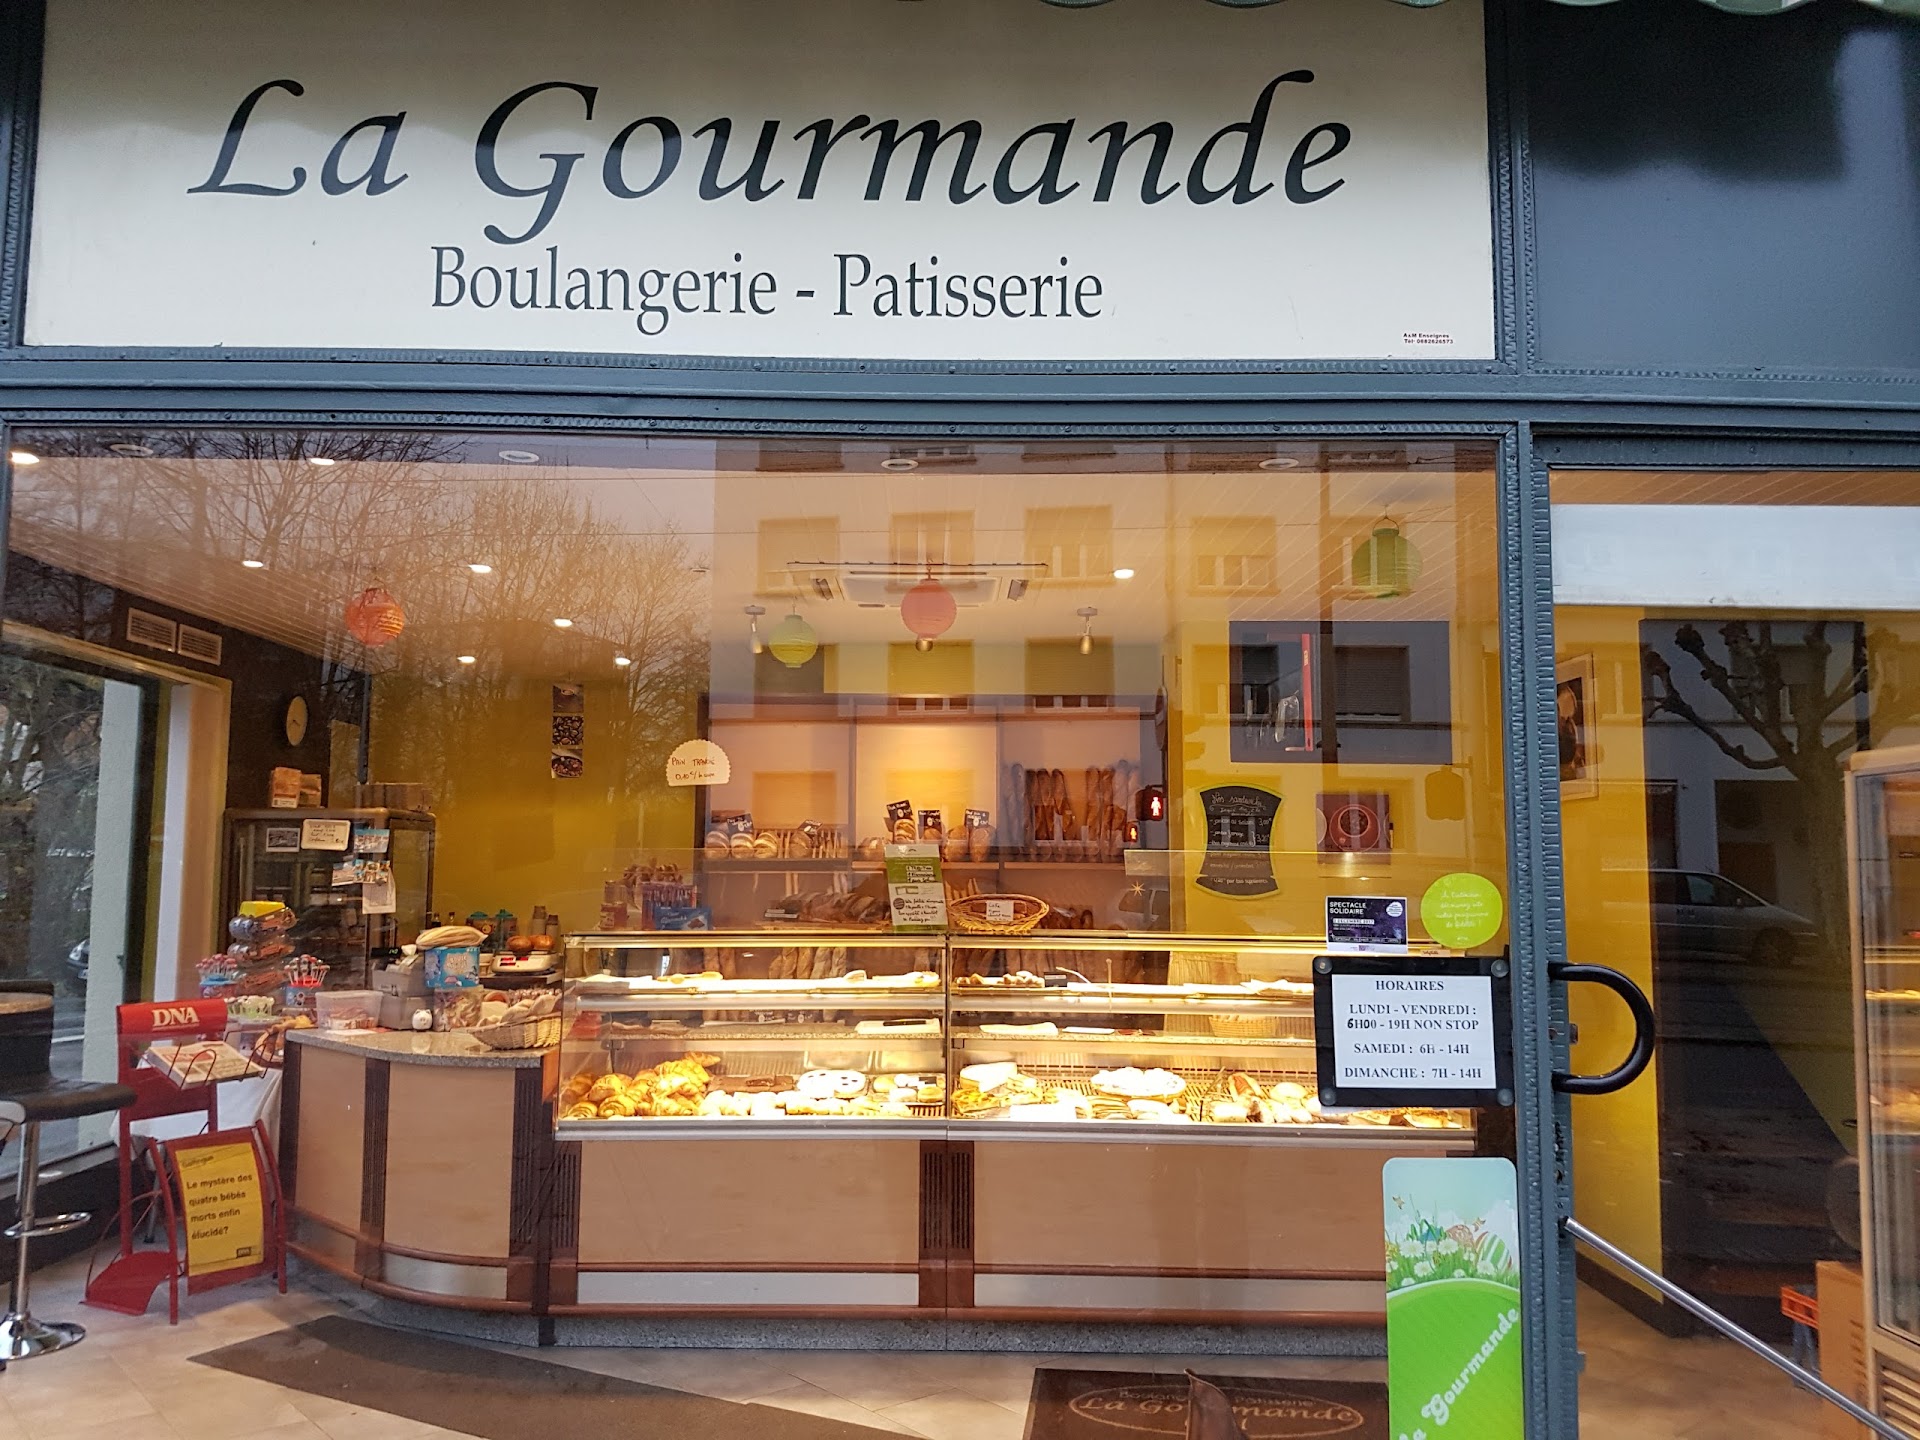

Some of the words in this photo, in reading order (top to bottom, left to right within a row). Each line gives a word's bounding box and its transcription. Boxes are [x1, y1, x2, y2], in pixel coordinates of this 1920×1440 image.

[187, 79, 408, 199] La
[475, 69, 1352, 244] Gourmande
[431, 245, 777, 336] Boulangerie
[796, 289, 815, 297] -
[832, 253, 1104, 319] Patisserie
[1329, 901, 1367, 909] SPECTACLE
[1376, 980, 1444, 991] HORAIRES
[152, 1006, 199, 1027] DNA
[1349, 1004, 1390, 1014] LUNDI
[1402, 1005, 1469, 1015] VENDREDI
[1347, 1018, 1377, 1029] 6H00
[1388, 1019, 1410, 1030] 19H
[1414, 1019, 1443, 1030] NON
[1445, 1020, 1479, 1030] STOP
[1354, 1043, 1405, 1054] SAMEDI
[1419, 1044, 1436, 1054] 6H
[1447, 1044, 1469, 1054] 14H
[1344, 1068, 1418, 1078] DIMANCHE
[1431, 1068, 1448, 1078] 7H
[1460, 1068, 1482, 1079] 14H
[186, 1181, 198, 1190] Le
[200, 1175, 235, 1188] mystère
[237, 1174, 252, 1183] des
[189, 1195, 218, 1207] quatre
[220, 1191, 246, 1201] bébés
[190, 1212, 216, 1223] morts
[219, 1208, 241, 1217] enfin
[191, 1226, 229, 1240] élucidé?
[1421, 1308, 1519, 1426] Gourmande
[1079, 1397, 1126, 1411] La
[1139, 1398, 1352, 1422] Gomande
